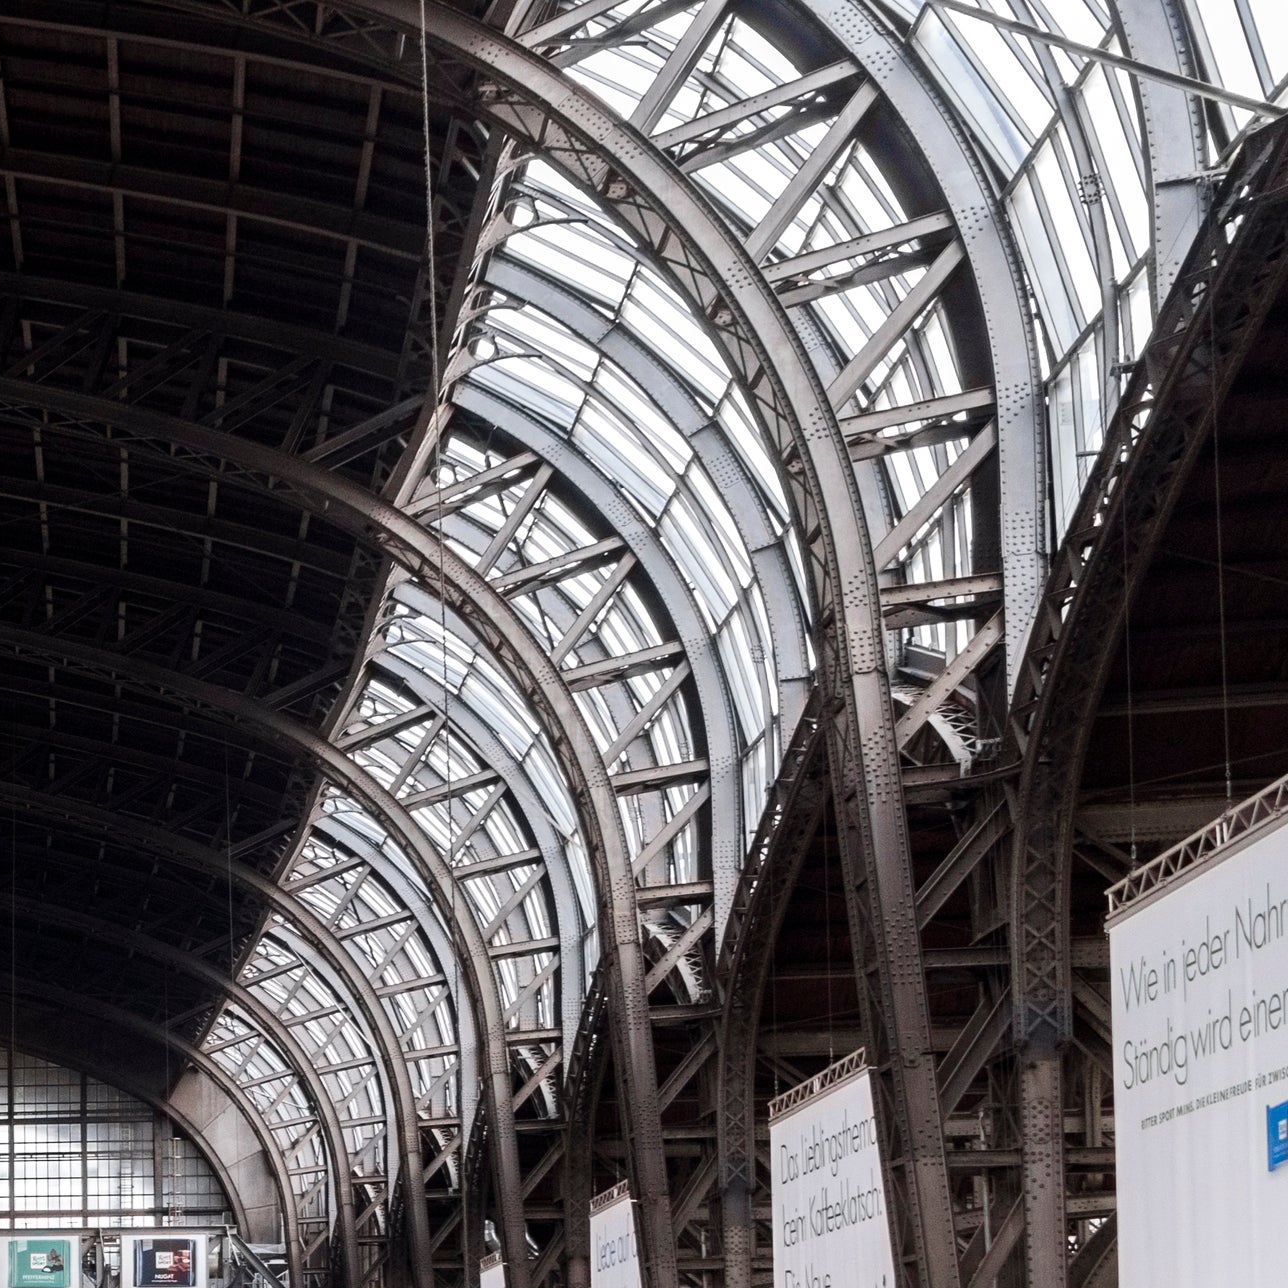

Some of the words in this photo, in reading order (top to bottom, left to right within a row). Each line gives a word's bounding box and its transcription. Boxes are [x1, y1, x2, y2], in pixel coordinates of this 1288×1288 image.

[1120, 955, 1159, 1013] Wie
[1162, 949, 1177, 994] in
[1182, 914, 1230, 1002] jeder
[1123, 1017, 1189, 1090] Ständig
[1190, 989, 1232, 1061] wird
[780, 1144, 800, 1185] Das
